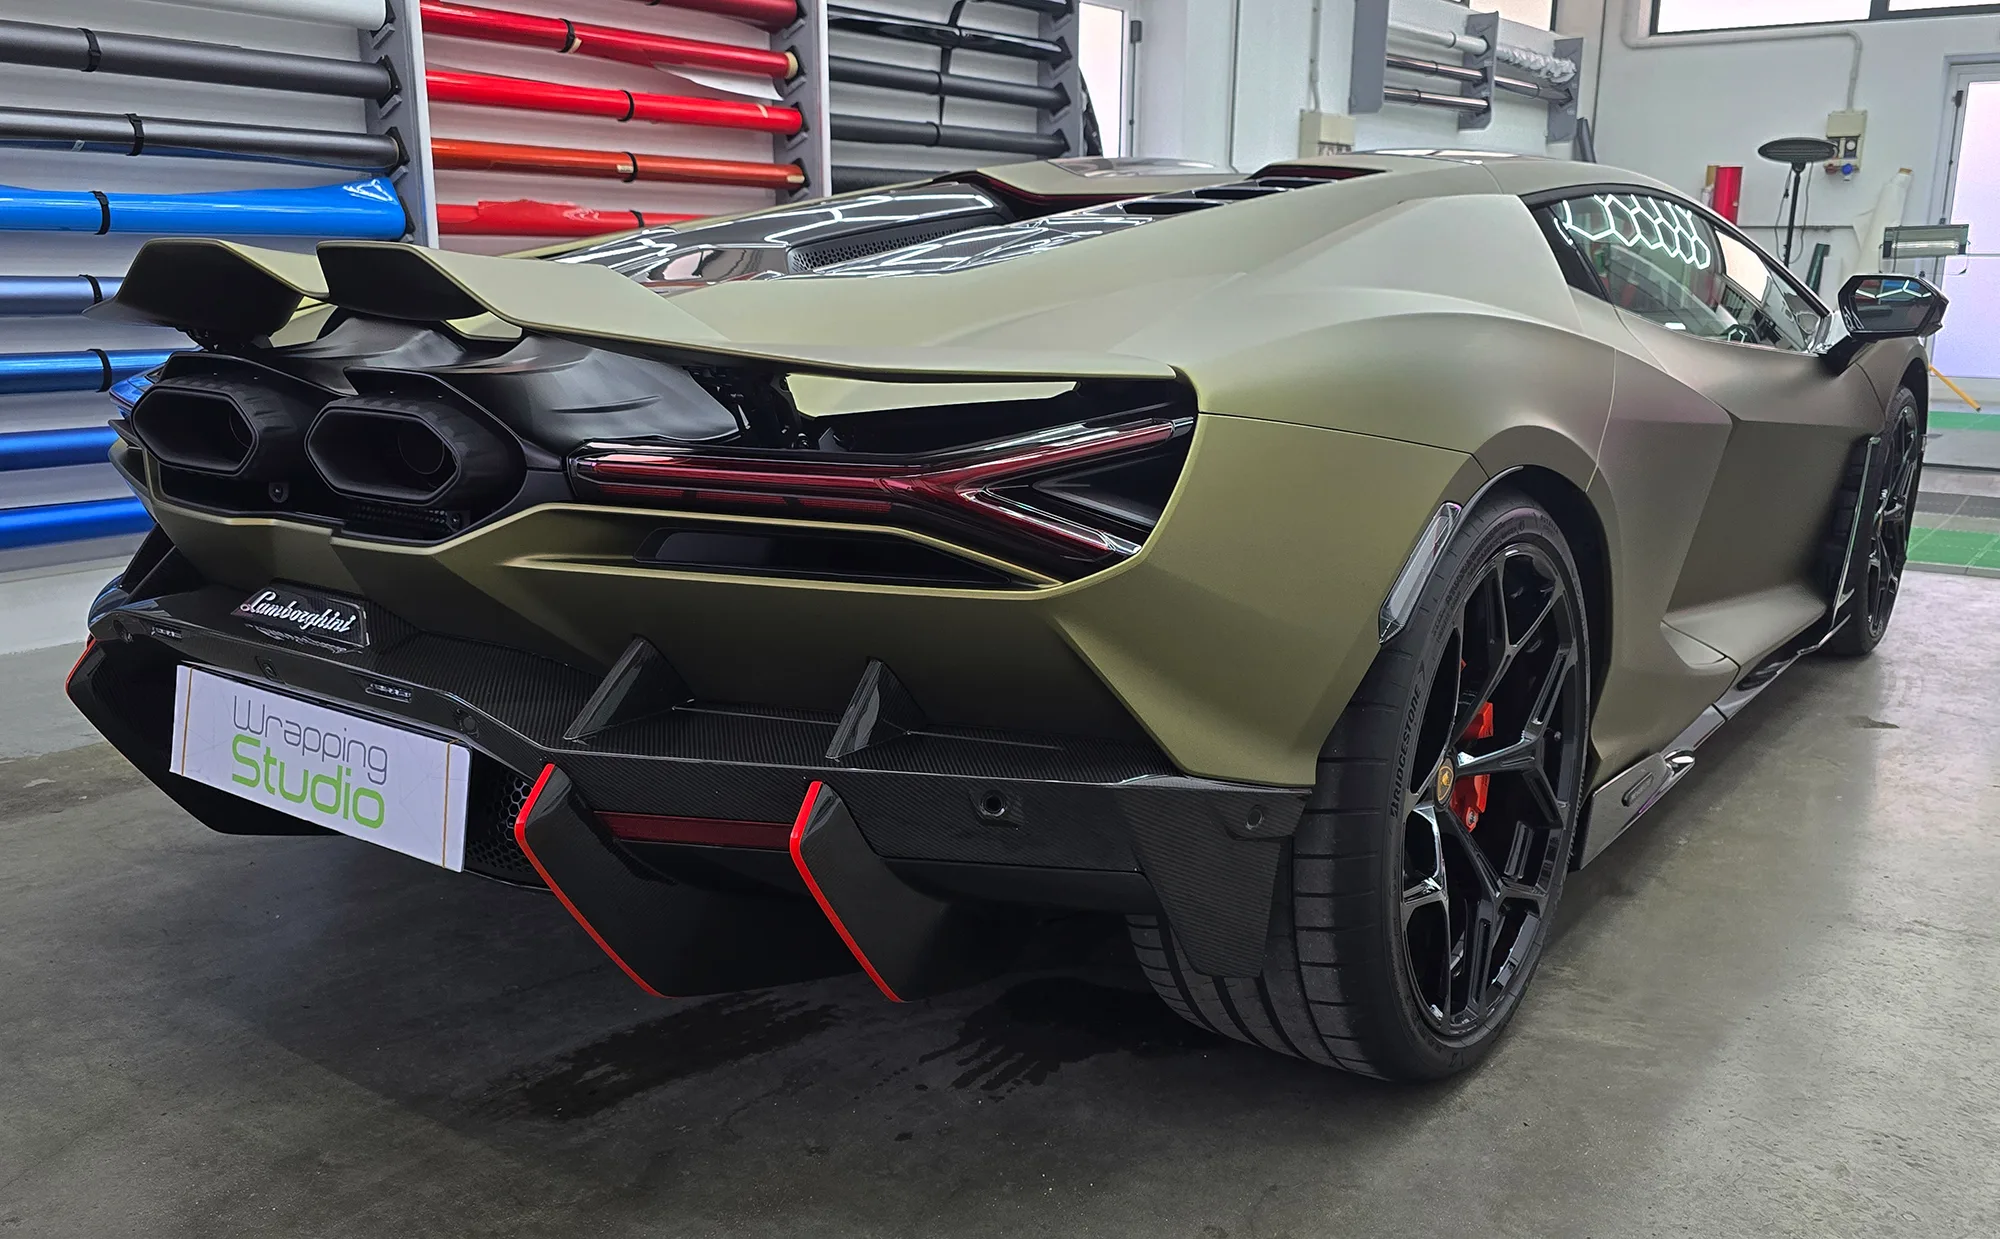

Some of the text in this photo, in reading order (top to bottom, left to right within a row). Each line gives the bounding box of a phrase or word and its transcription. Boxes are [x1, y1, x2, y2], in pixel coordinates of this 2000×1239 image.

[240, 591, 357, 632] Lamborghini
[232, 733, 385, 829] Studio
[233, 695, 388, 785] Wrapping
[1390, 684, 1422, 819] BRIDGESTONE
